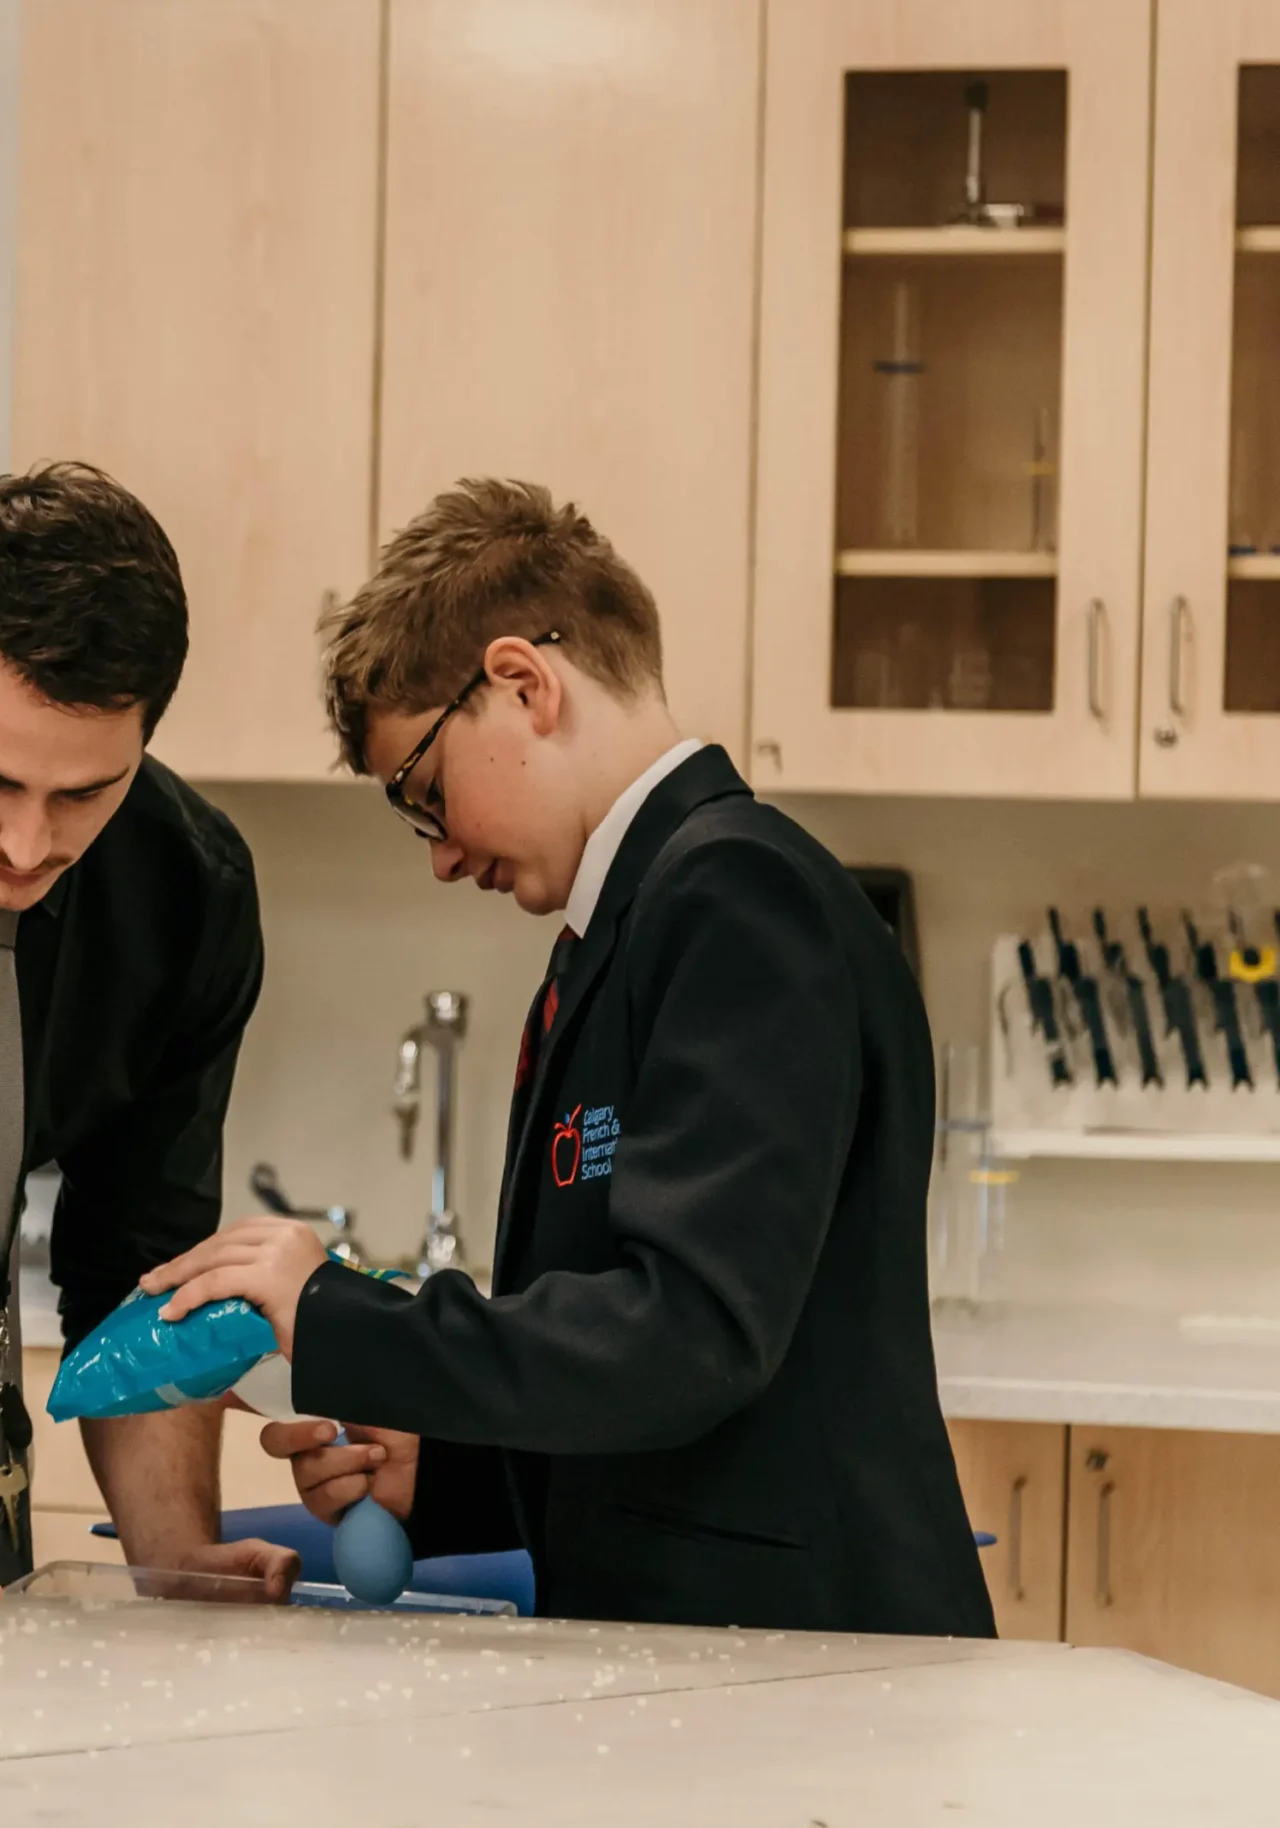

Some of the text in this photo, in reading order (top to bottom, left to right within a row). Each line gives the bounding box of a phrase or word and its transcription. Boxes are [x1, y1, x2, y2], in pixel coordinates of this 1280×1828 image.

[584, 1106, 614, 1126] Calgary
[583, 1118, 620, 1144] French &
[582, 1157, 612, 1180] School
